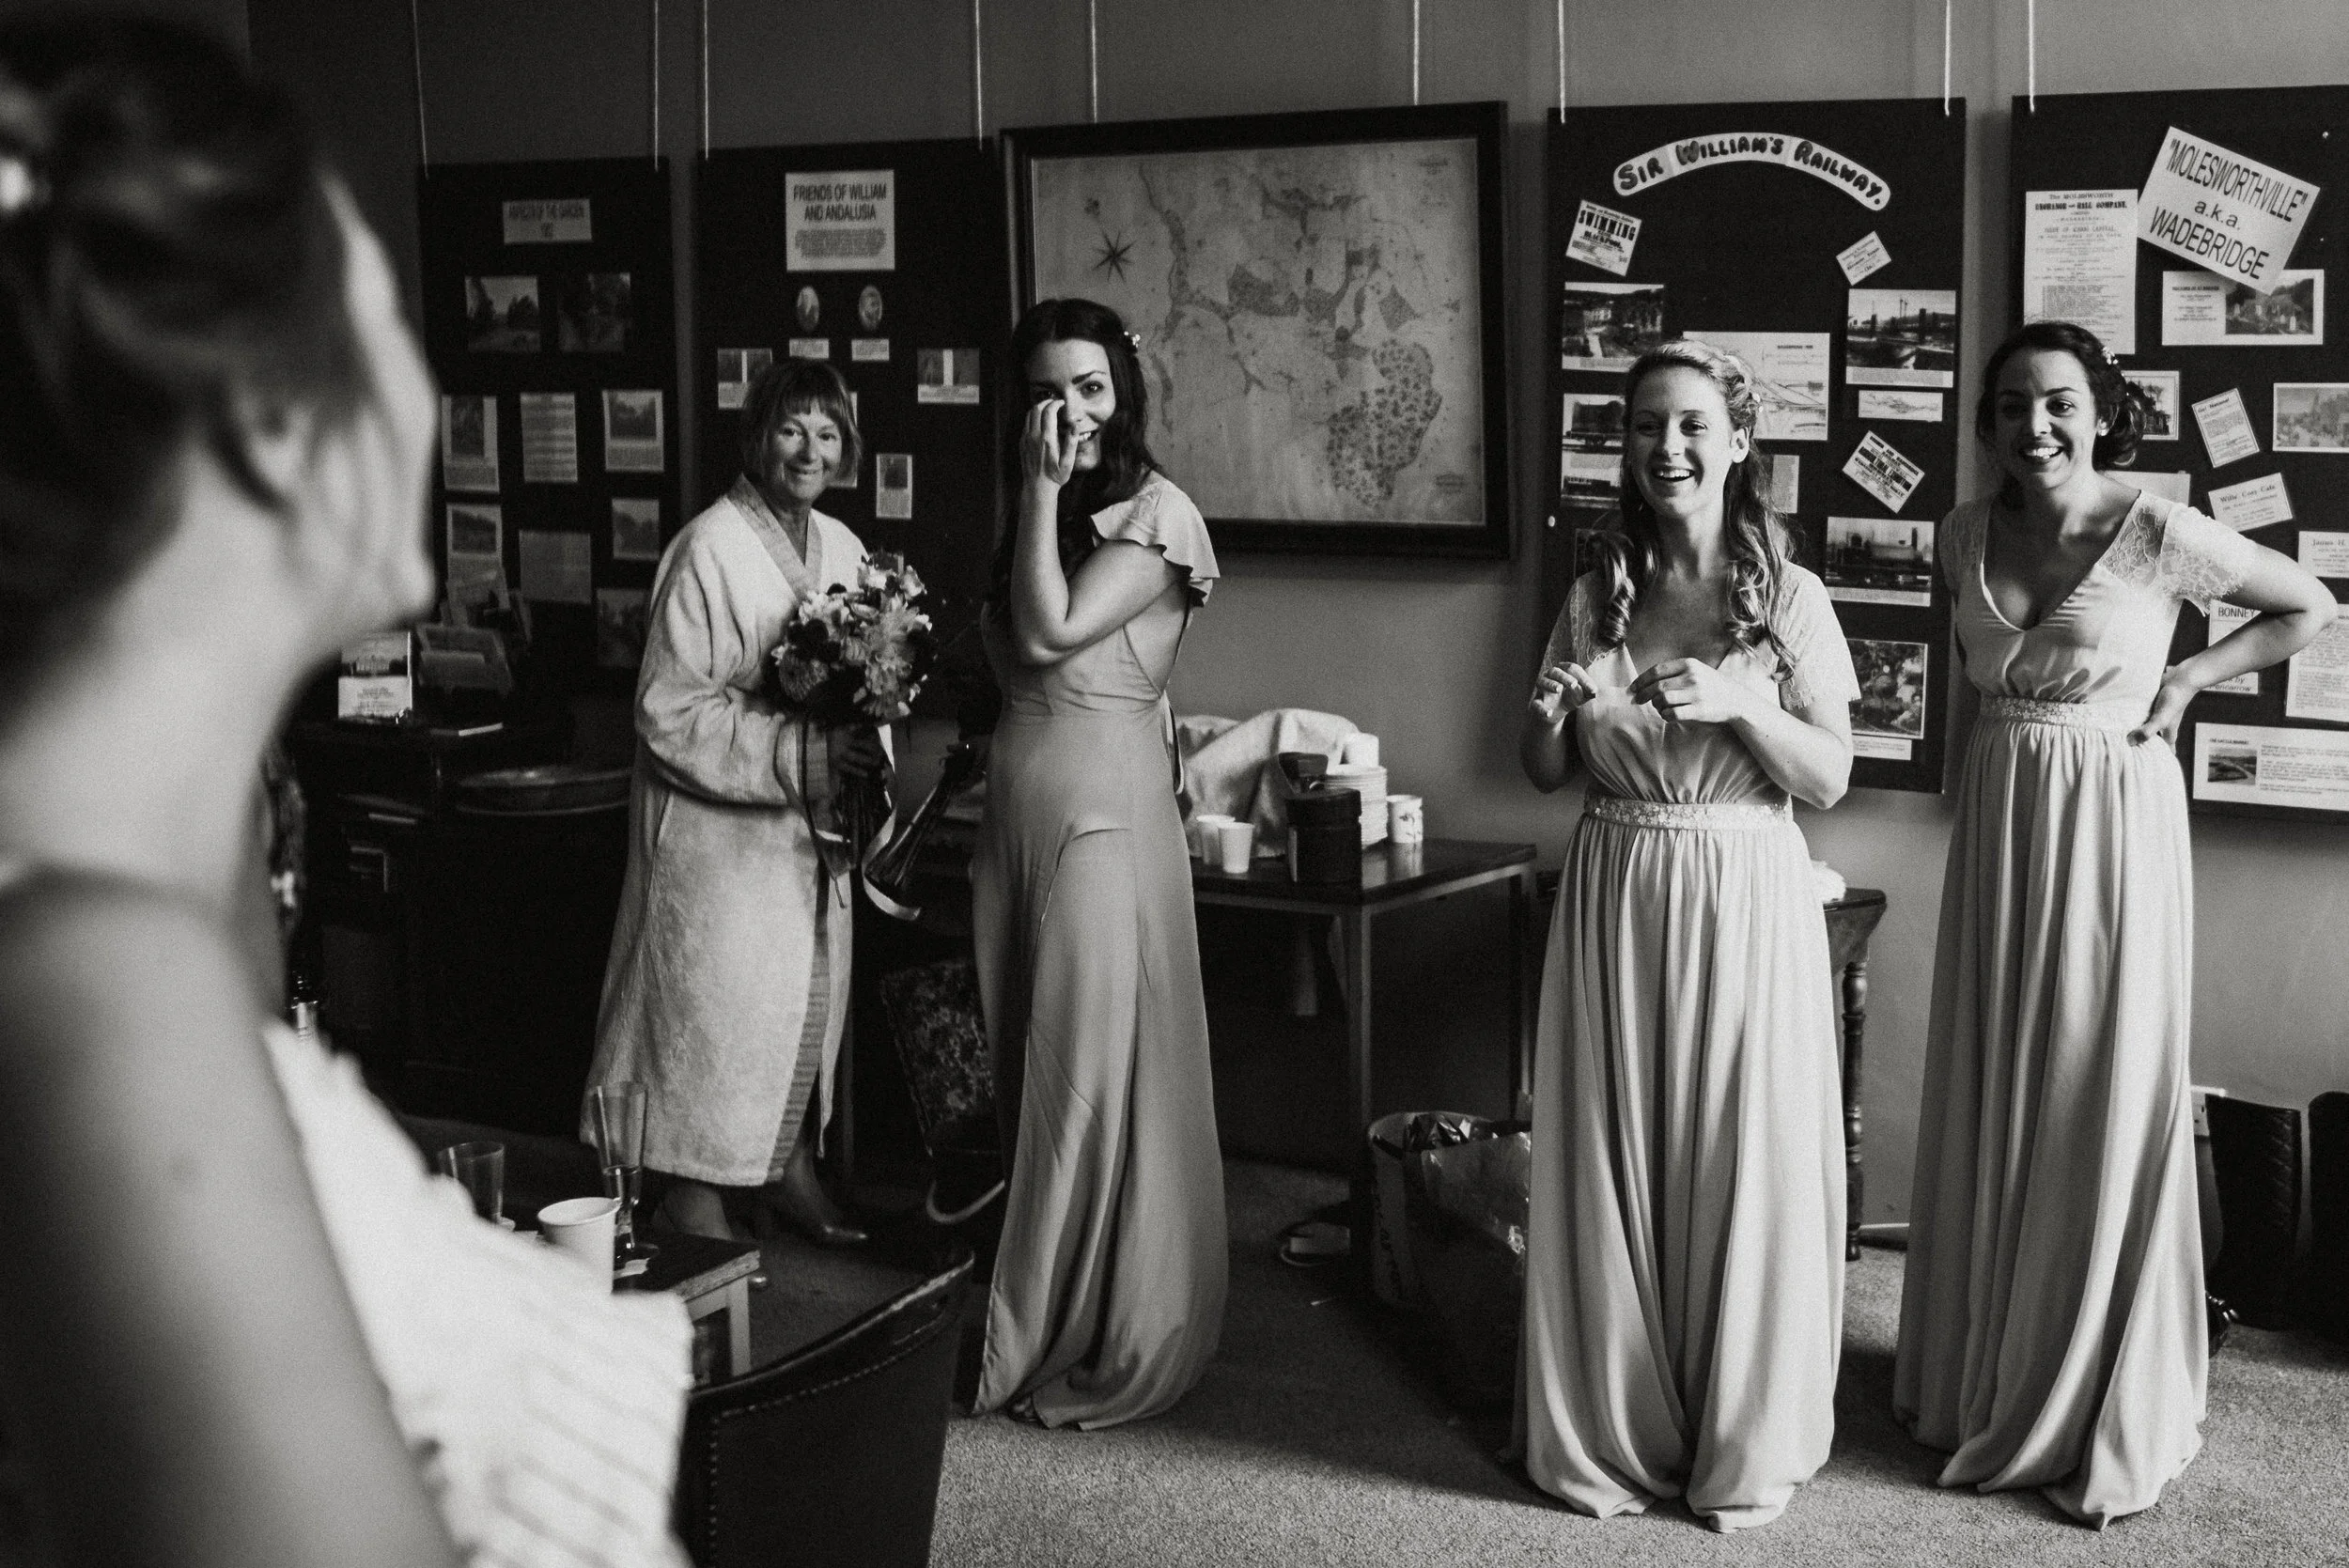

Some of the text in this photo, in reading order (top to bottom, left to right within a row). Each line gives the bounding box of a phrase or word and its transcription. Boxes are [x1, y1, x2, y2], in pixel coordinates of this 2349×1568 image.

[1617, 157, 1664, 191] SIR
[1675, 136, 1784, 166] WILLIAM'S
[793, 182, 887, 202] FRIENDS OF WILLIAM
[804, 204, 877, 221] AND ANDALUSIA
[1579, 210, 1637, 241] SWIMMING
[2194, 200, 2241, 230] a.k.a.
[2150, 206, 2270, 280] WADEBRIDGE
[2217, 607, 2255, 618] BONNEY
